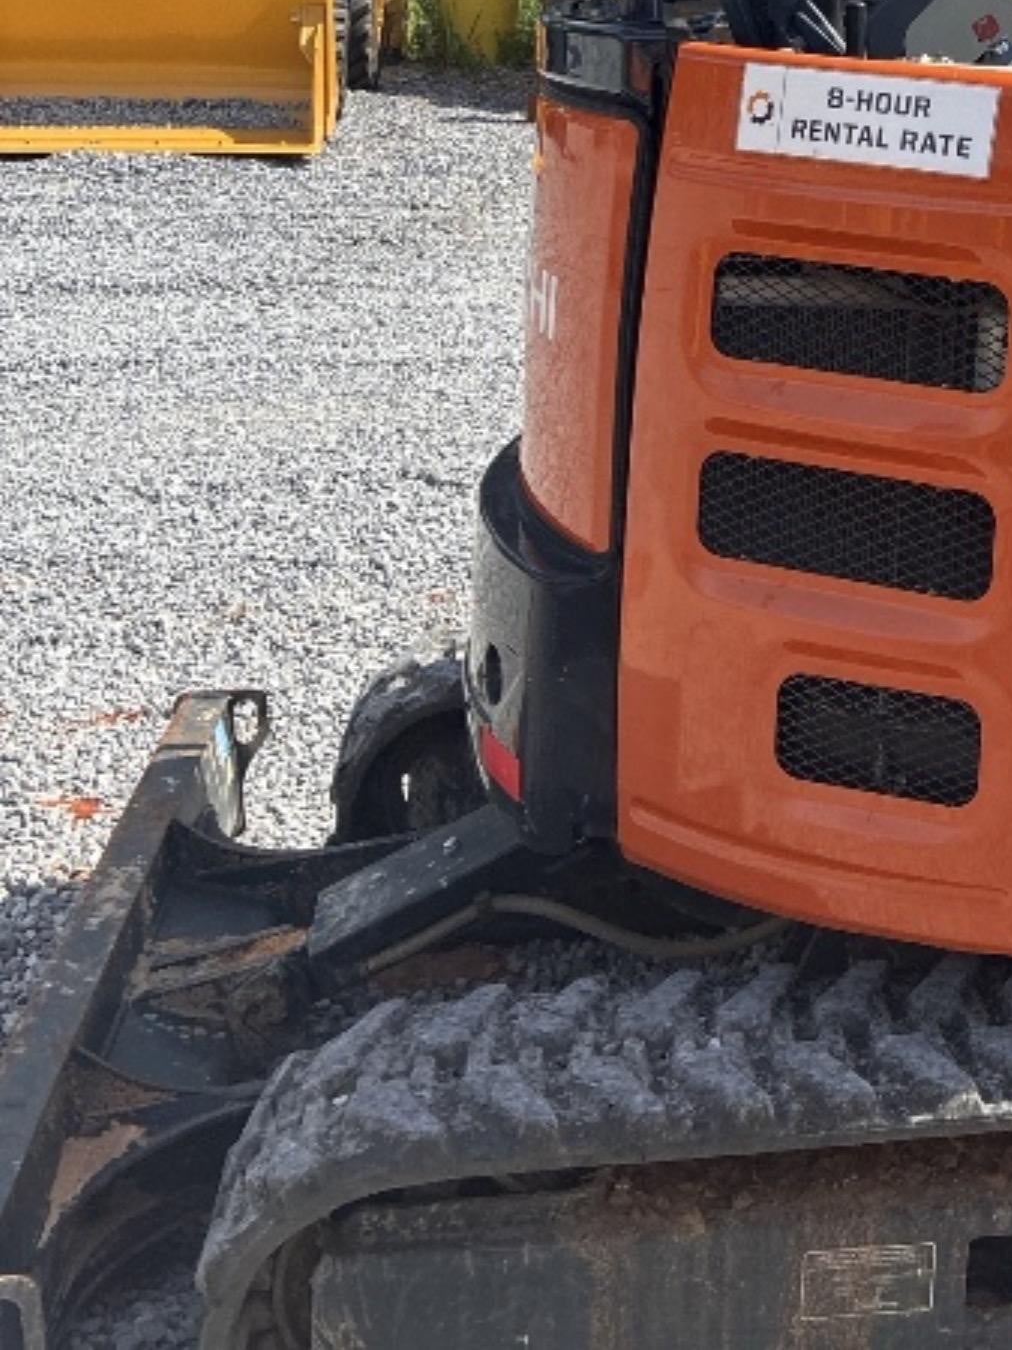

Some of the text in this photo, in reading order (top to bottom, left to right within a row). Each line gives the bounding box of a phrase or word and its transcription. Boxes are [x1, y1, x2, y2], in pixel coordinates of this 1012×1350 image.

[827, 88, 931, 118] 8-HOUR
[790, 120, 972, 159] RENTAL RATE
